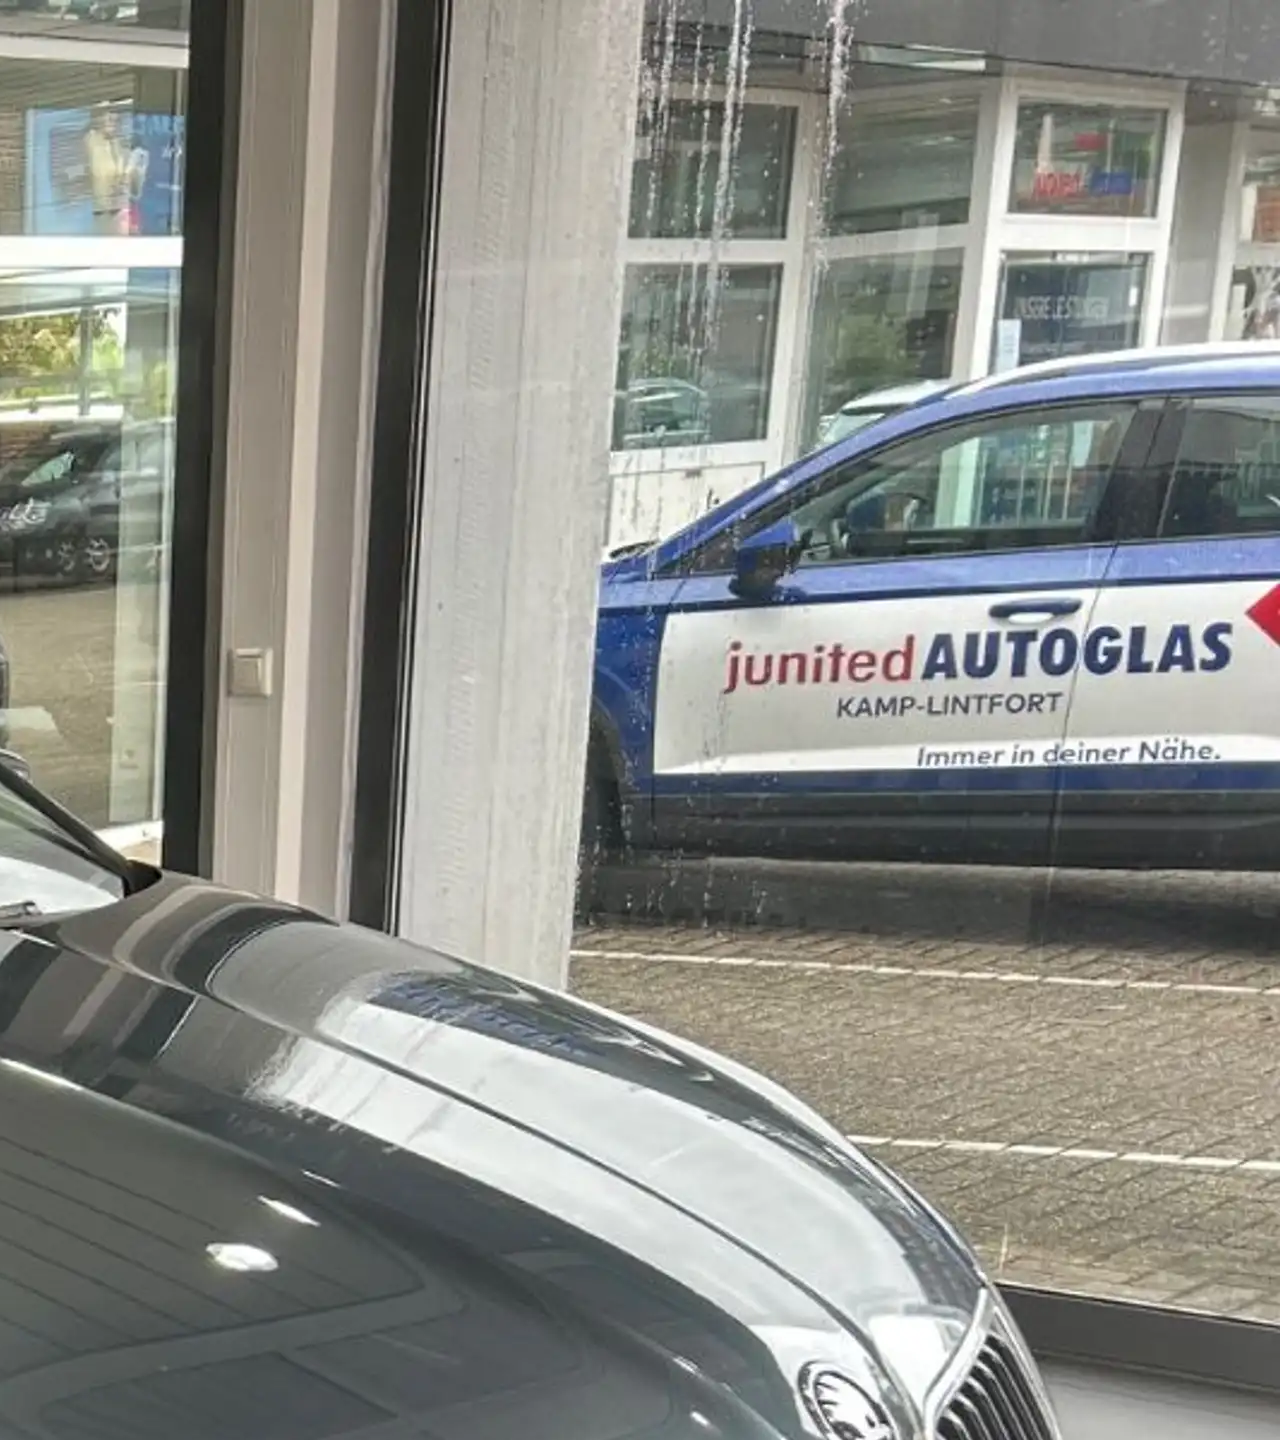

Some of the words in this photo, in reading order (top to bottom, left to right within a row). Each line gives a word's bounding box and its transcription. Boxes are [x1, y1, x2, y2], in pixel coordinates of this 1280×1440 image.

[723, 633, 916, 695] junited
[920, 622, 1234, 681] AUTOGLAS
[836, 691, 1064, 719] KAMP-LINTFORT
[916, 745, 1005, 767] Immer
[1010, 744, 1034, 765] in
[1042, 743, 1131, 764] deiner
[1138, 737, 1222, 762] Nähe.
